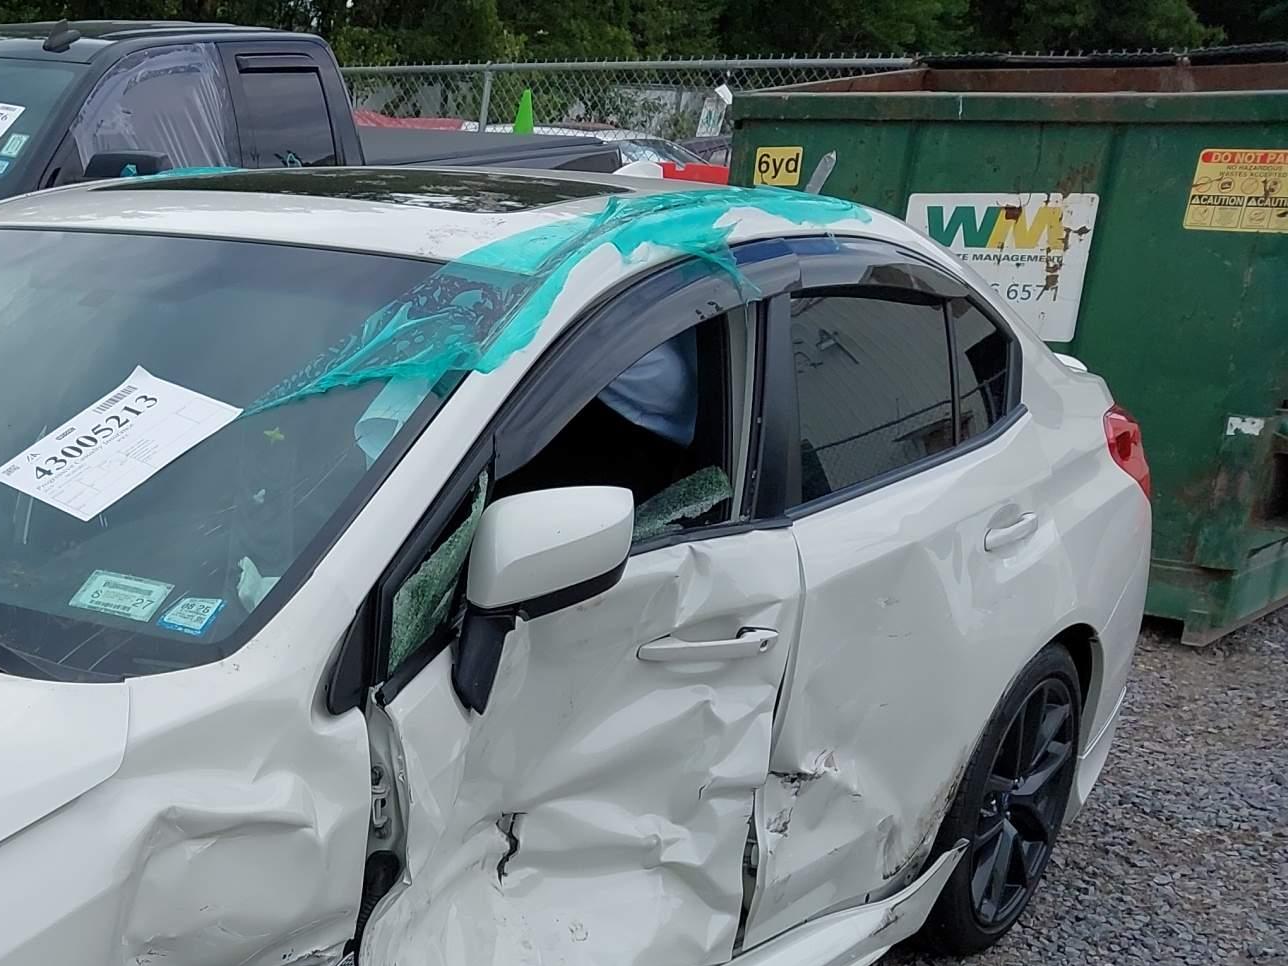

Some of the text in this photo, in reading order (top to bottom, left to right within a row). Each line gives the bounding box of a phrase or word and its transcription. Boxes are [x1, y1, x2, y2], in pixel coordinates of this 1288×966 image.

[1212, 152, 1288, 164] DO NOT PA
[758, 153, 800, 179] 6yd
[1201, 195, 1244, 206] CAUTION
[927, 206, 1063, 249] WM
[972, 253, 1063, 262] MANAGEMENT
[1006, 284, 1059, 302] 6571
[35, 395, 158, 479] 43005213
[132, 598, 154, 610] 27
